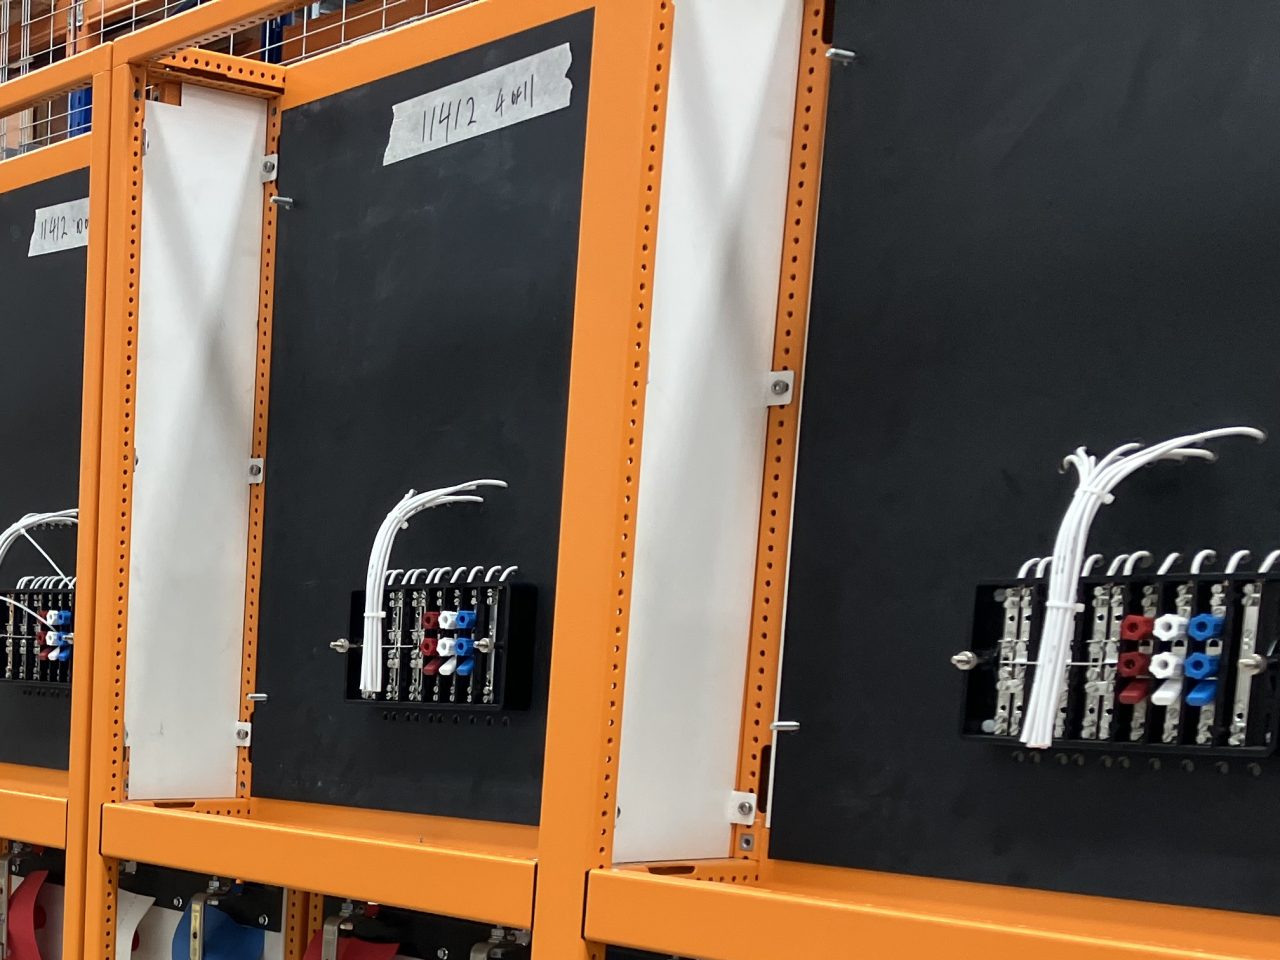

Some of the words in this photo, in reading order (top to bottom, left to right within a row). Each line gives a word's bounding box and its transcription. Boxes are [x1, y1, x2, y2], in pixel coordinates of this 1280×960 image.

[421, 96, 477, 143] 11412
[495, 88, 505, 117] 4
[40, 215, 68, 241] 11412
